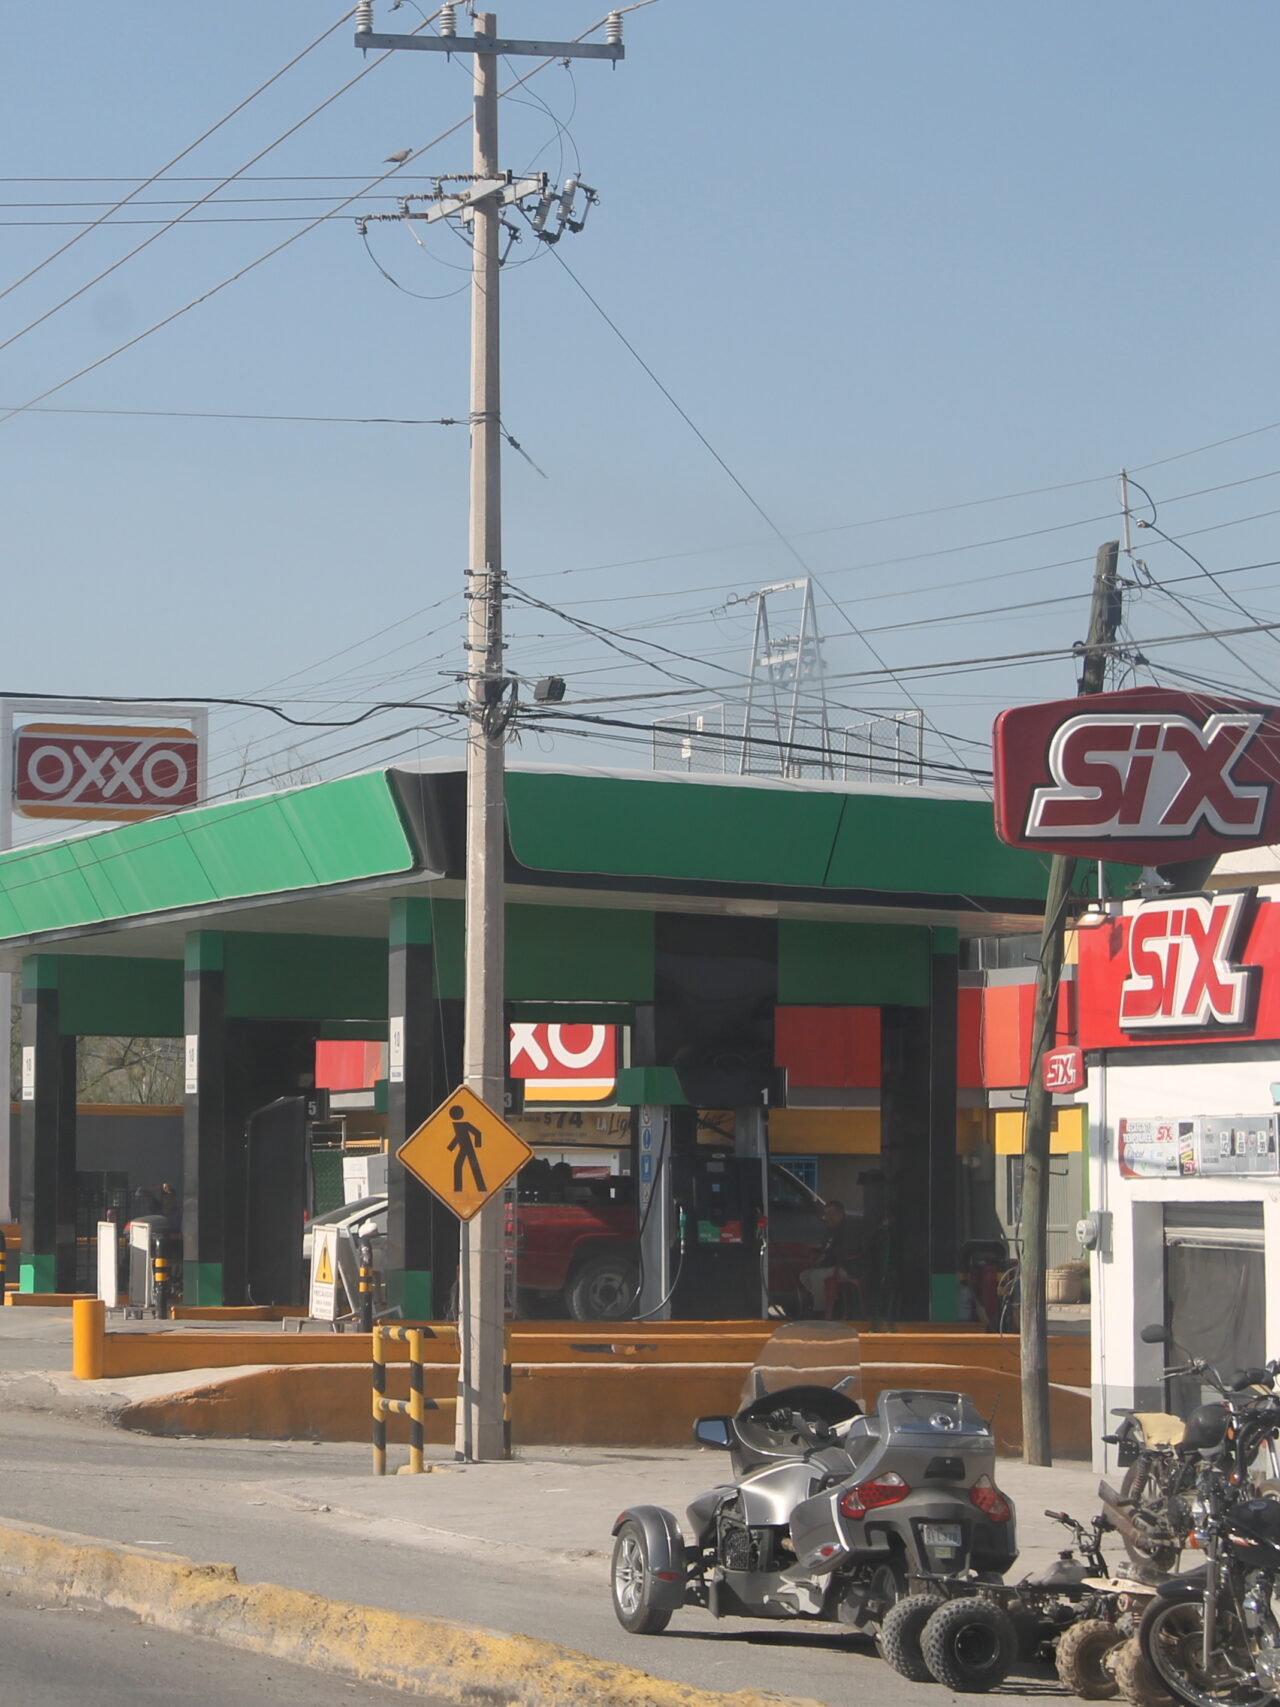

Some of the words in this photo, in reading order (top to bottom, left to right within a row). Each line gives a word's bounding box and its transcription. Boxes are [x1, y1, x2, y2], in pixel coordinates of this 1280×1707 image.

[27, 744, 188, 799] OXXO
[510, 1023, 606, 1071] XO
[504, 1092, 512, 1108] 3
[760, 1087, 768, 1105] 1
[308, 1101, 317, 1116] 5
